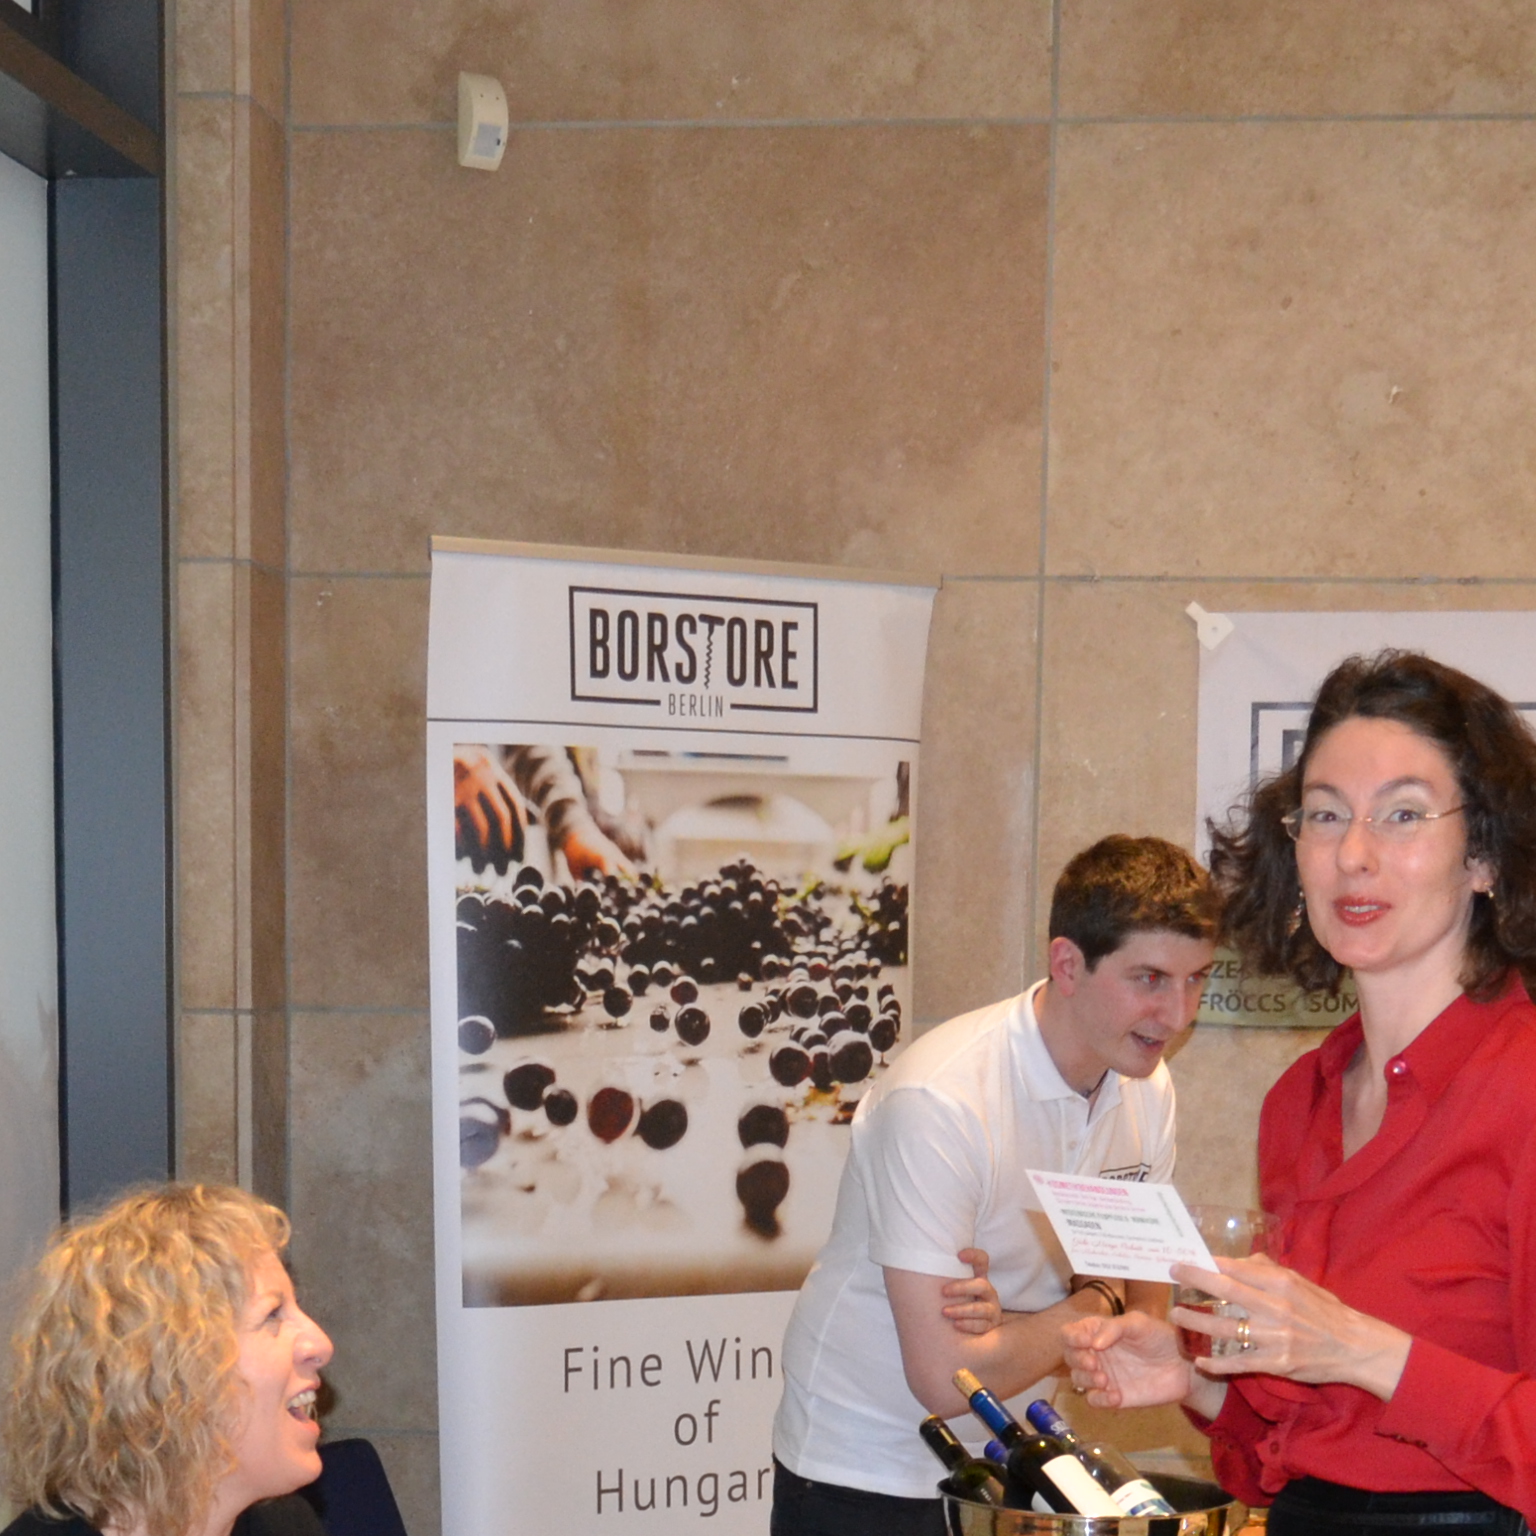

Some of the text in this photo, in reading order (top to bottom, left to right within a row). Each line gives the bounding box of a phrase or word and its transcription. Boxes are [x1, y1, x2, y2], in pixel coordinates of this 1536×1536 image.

[588, 606, 800, 690] BORSTORE
[667, 692, 724, 717] BERLIN
[1307, 993, 1360, 1013] SOM
[564, 1336, 773, 1393] Fine Win
[674, 1399, 721, 1446] of
[596, 1467, 771, 1518] Hungar
